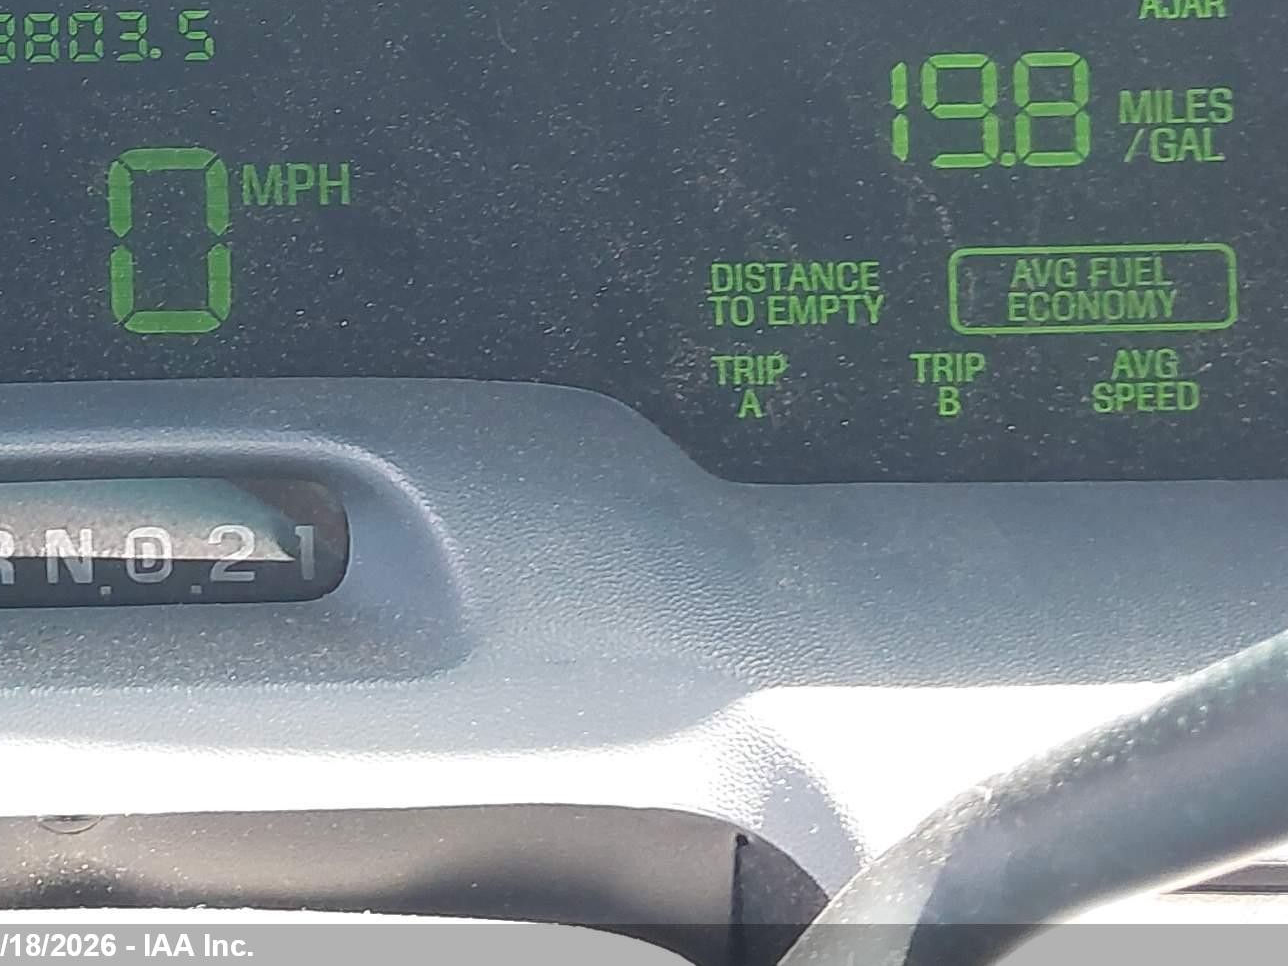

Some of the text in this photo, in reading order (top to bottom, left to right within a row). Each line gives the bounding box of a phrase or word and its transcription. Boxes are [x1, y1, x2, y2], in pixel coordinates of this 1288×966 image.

[891, 51, 1090, 168] 19.8
[1118, 88, 1234, 124] MILES
[1123, 128, 1225, 162] /GAL
[110, 147, 351, 332] 0 MPH
[709, 262, 880, 293] DISTANCE
[1011, 256, 1173, 288] AVG FUEL
[707, 294, 884, 326] TO EMPTY
[1008, 289, 1177, 321] ECONOMY
[711, 353, 788, 385] TRIP
[910, 352, 986, 383] TRIP
[1111, 349, 1178, 379] AVG
[738, 389, 764, 418] A
[938, 387, 960, 416] B
[1092, 382, 1199, 412] SPEED
